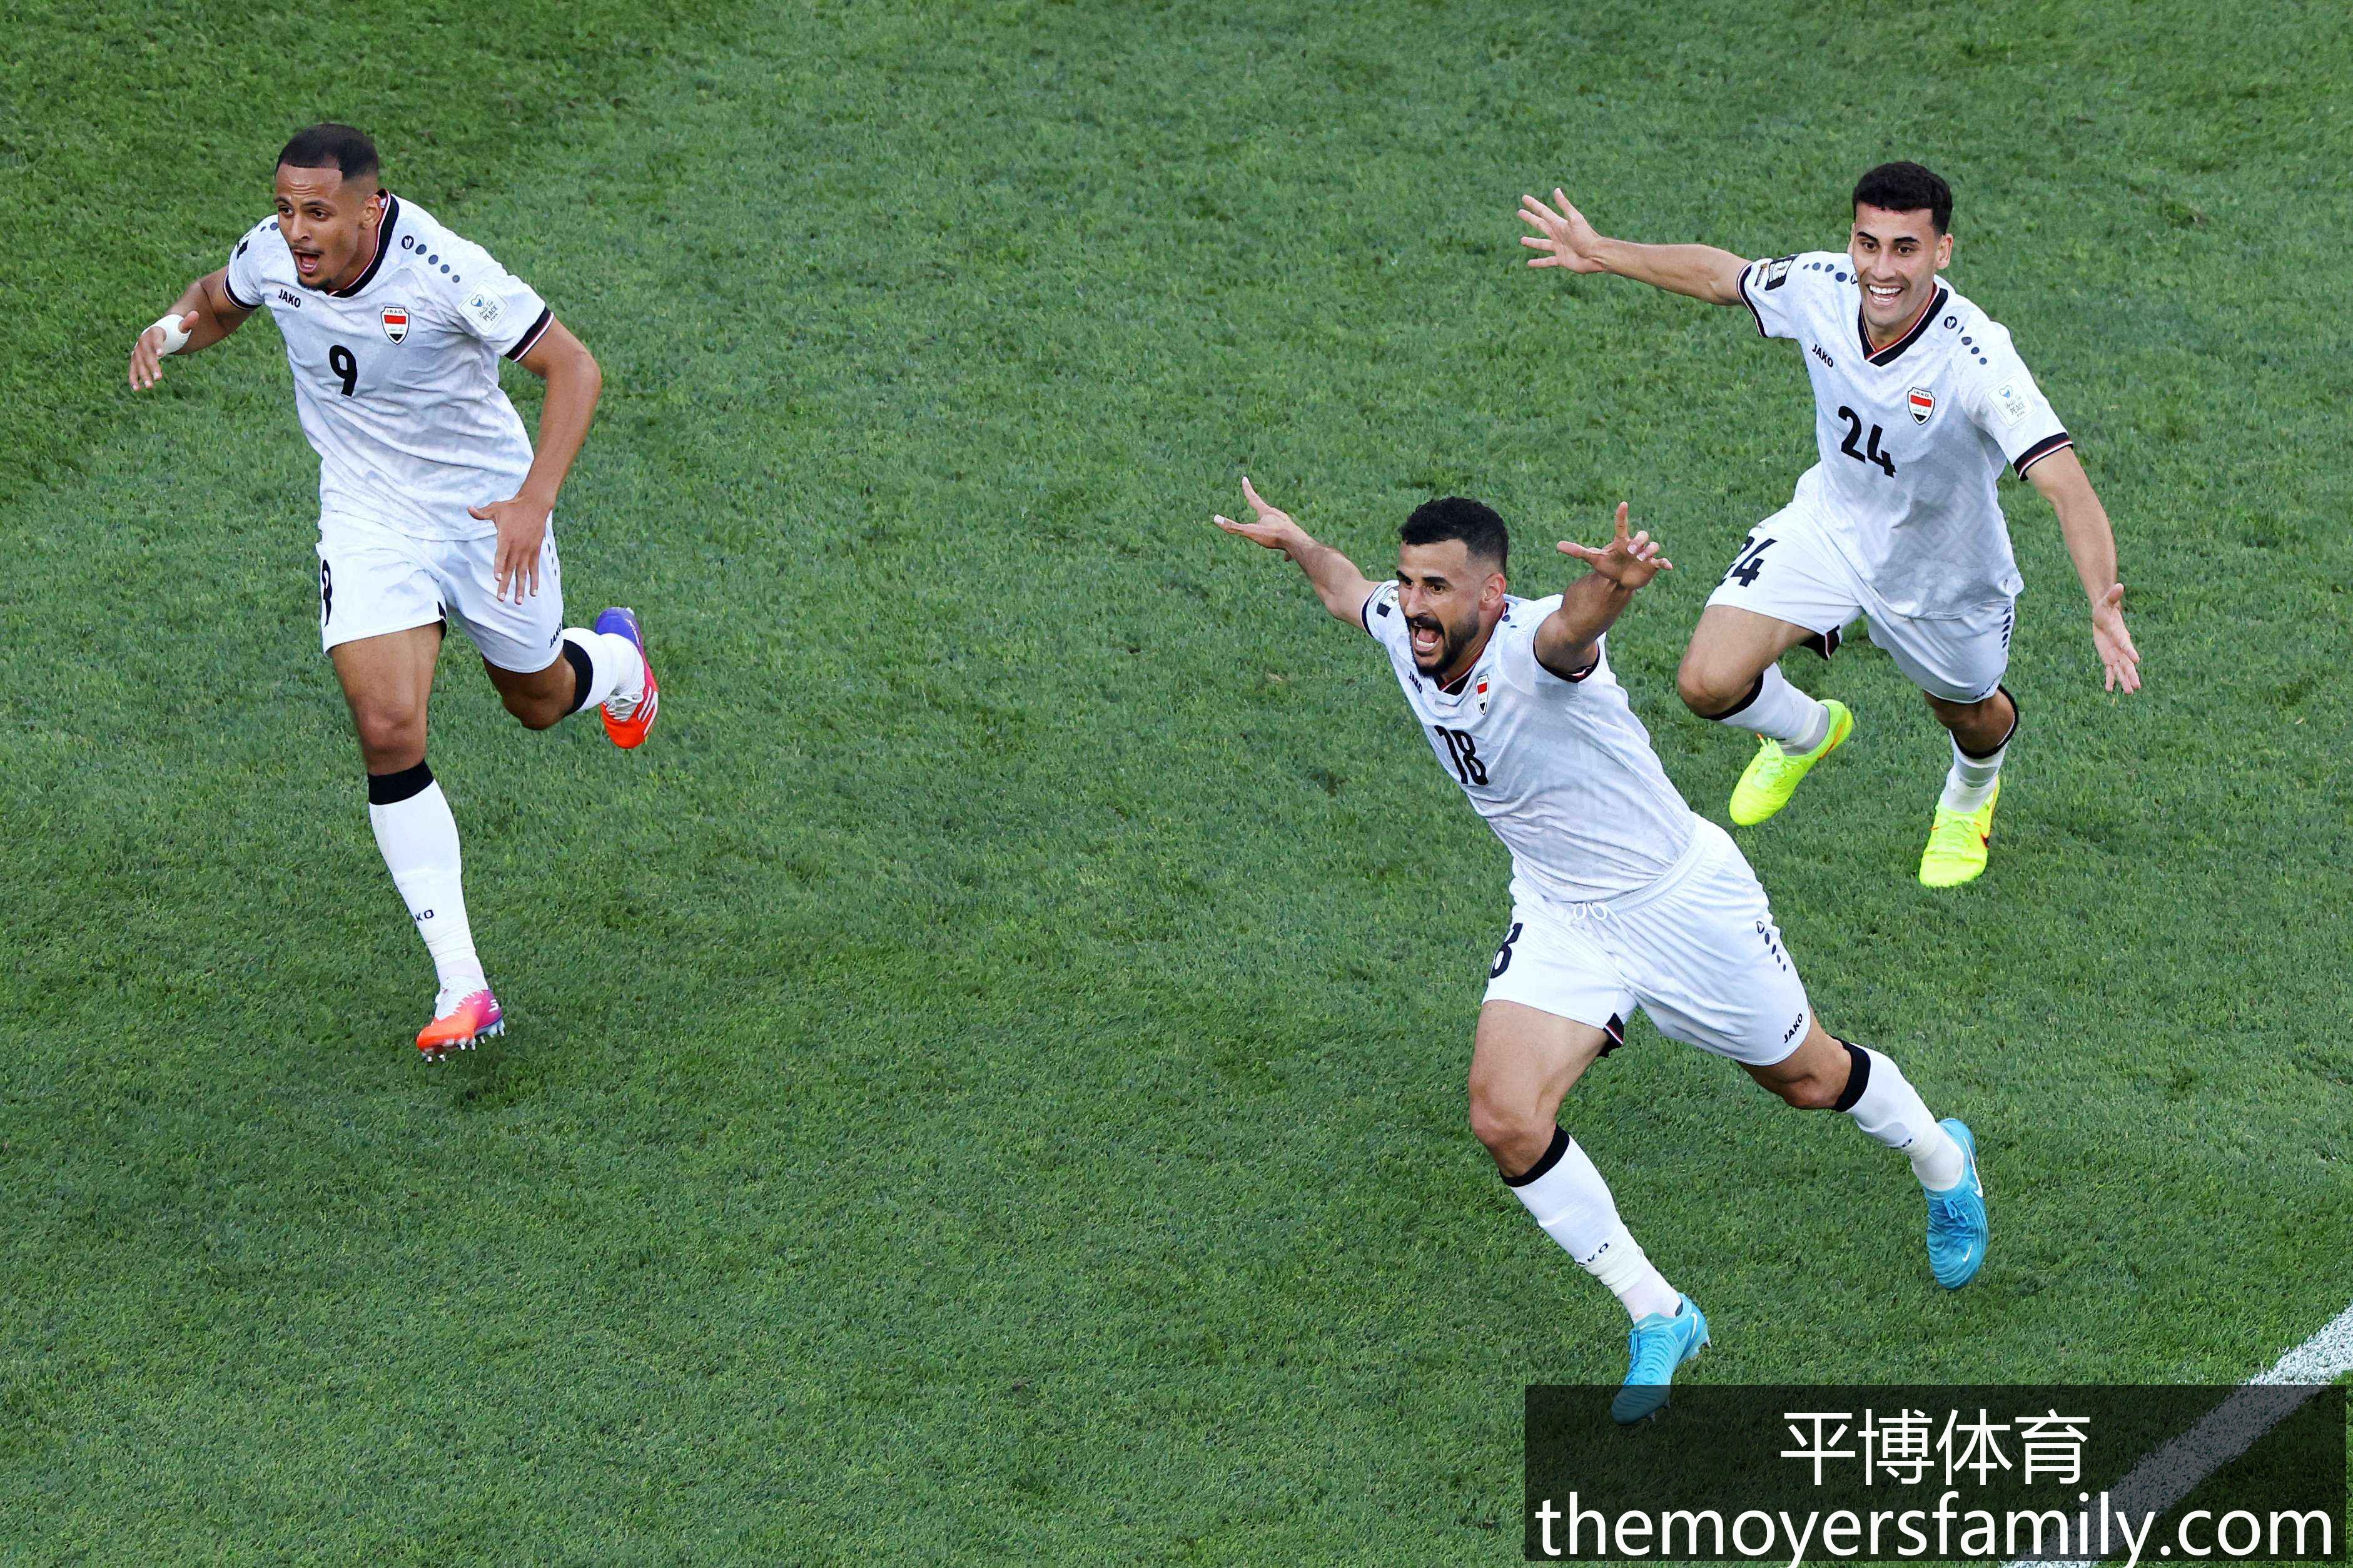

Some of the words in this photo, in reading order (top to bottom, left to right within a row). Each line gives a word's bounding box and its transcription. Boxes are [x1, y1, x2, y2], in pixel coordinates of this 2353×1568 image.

[278, 288, 301, 308] JAKO
[483, 304, 498, 321] PEACE
[1811, 343, 1833, 368] JAKO
[328, 345, 358, 397] 9
[1838, 405, 1896, 478] 24
[322, 559, 332, 627] 9
[550, 622, 562, 649] JAKO
[1409, 670, 1422, 694] JAKO
[1434, 725, 1489, 786] 18
[1784, 1013, 1803, 1044] JAKO
